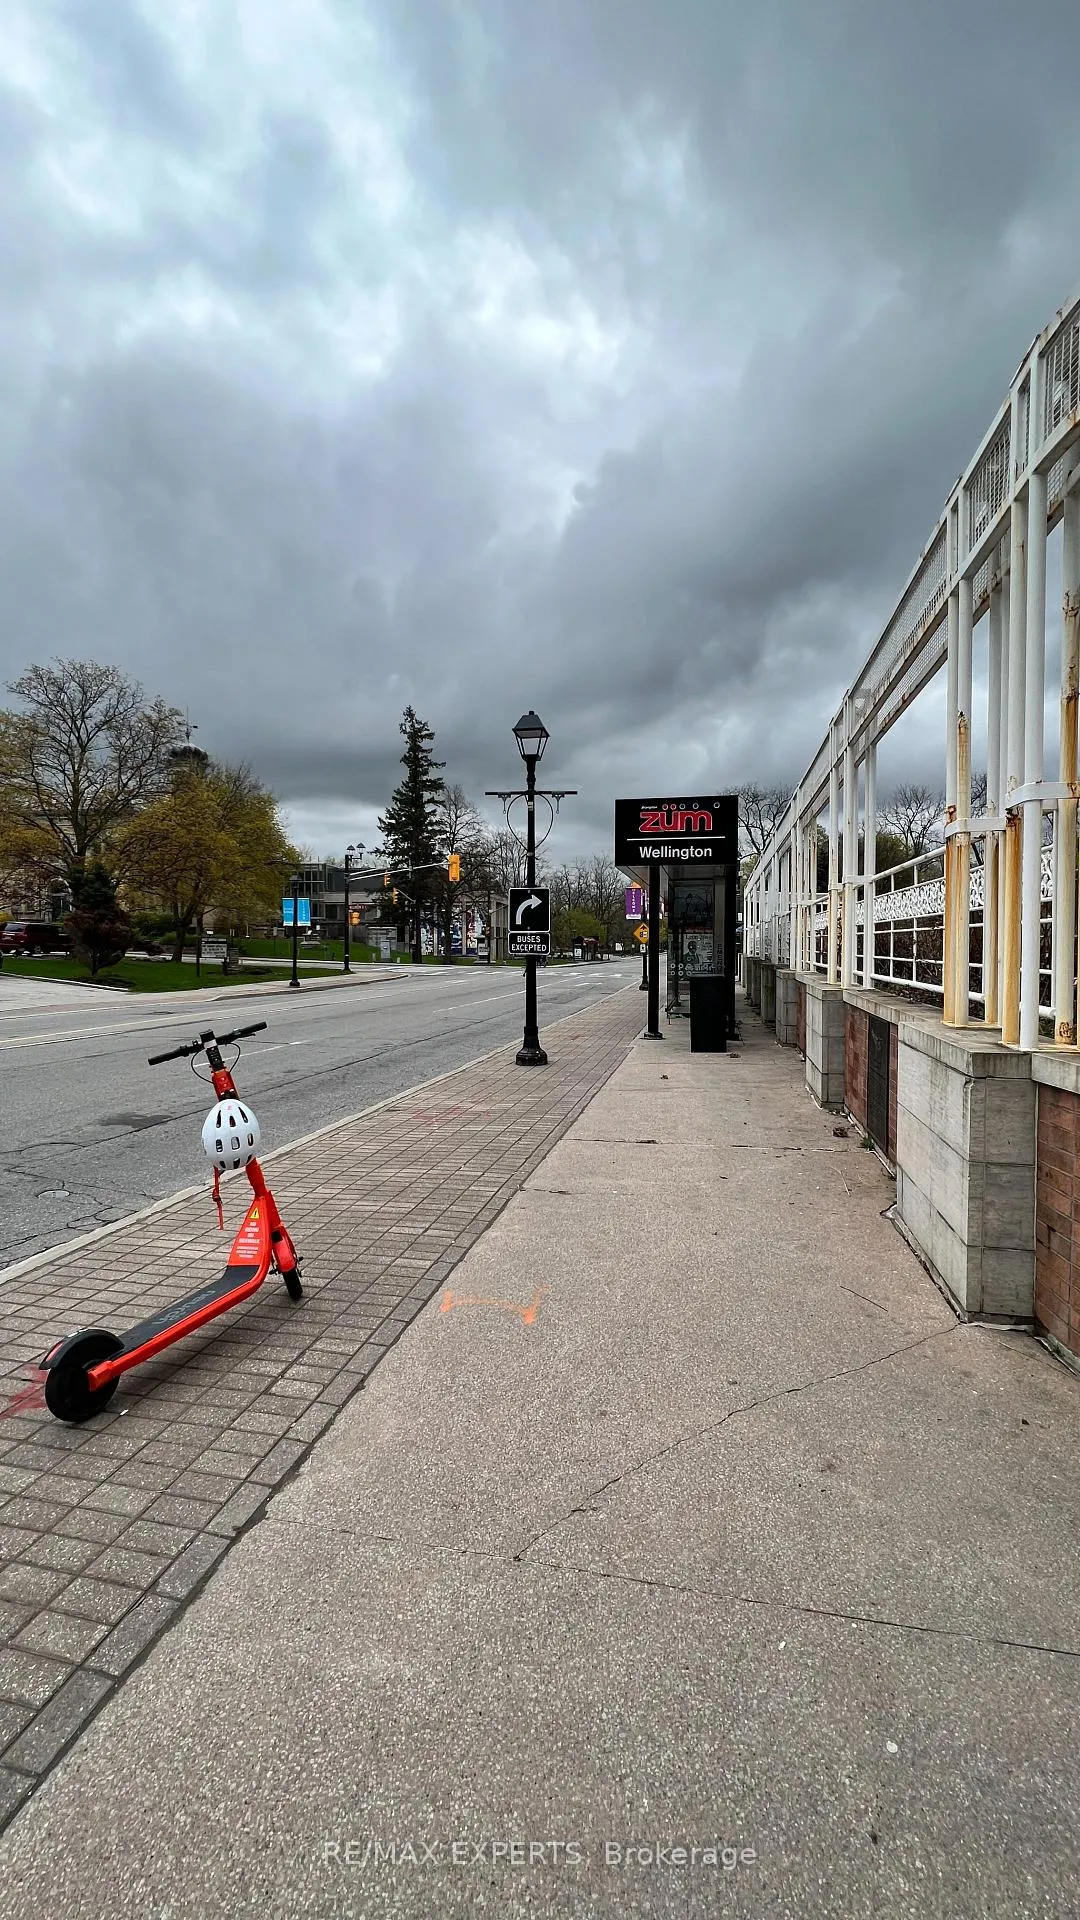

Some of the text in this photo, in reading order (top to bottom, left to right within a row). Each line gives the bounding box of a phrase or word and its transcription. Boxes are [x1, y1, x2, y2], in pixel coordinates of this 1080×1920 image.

[639, 845, 712, 860] Wellington
[517, 935, 541, 943] BUSES
[511, 943, 547, 952] EXCEPTED
